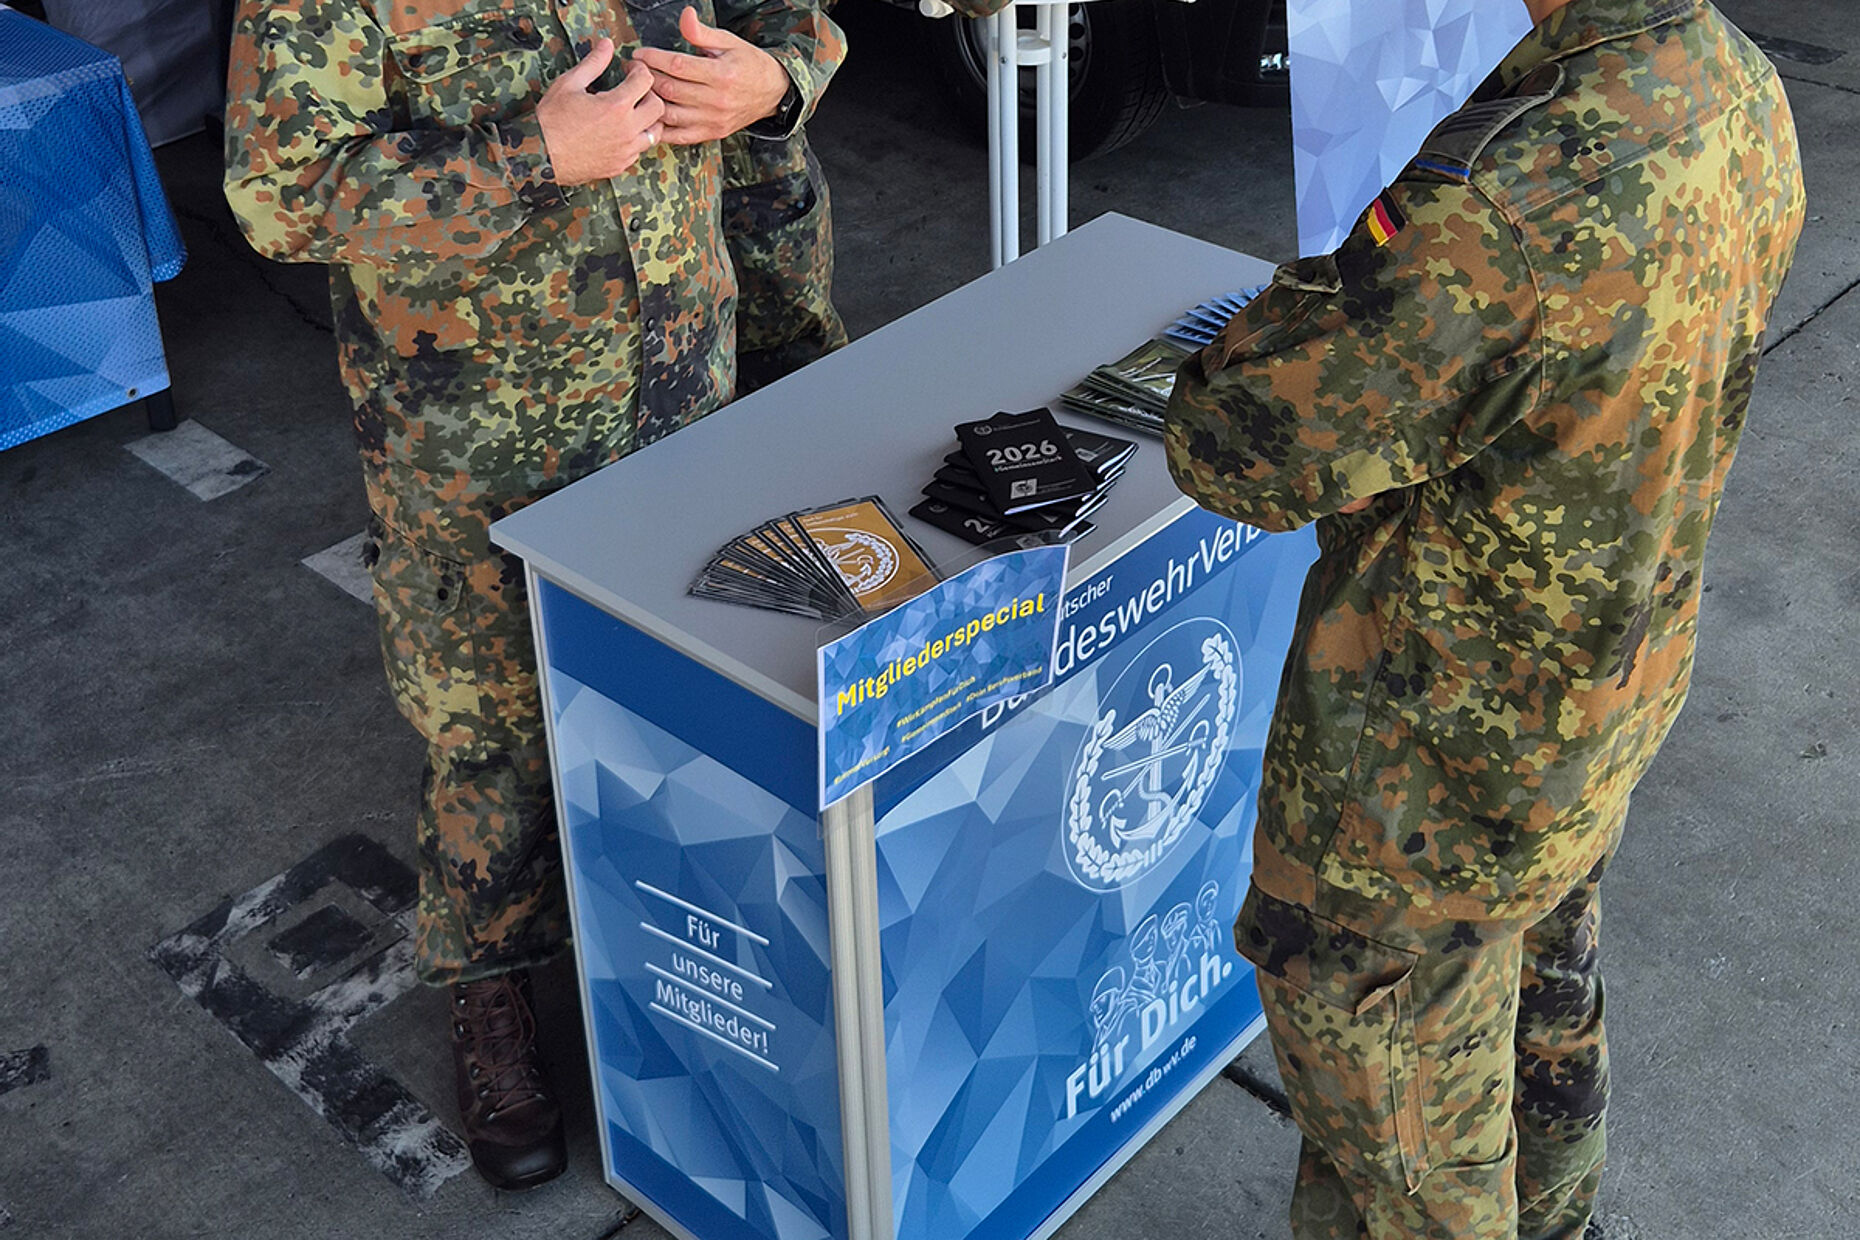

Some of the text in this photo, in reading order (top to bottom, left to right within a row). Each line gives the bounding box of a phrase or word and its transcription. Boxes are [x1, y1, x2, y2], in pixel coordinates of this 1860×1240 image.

[986, 439, 1058, 465] 2026
[837, 592, 1045, 716] Mitgliederspecial
[687, 914, 720, 949] Für
[672, 952, 744, 1001] unsere
[656, 978, 769, 1055] Mitglieder!
[1065, 951, 1233, 1120] Für Dich.
[1110, 1034, 1198, 1124] www.dbwv.de
